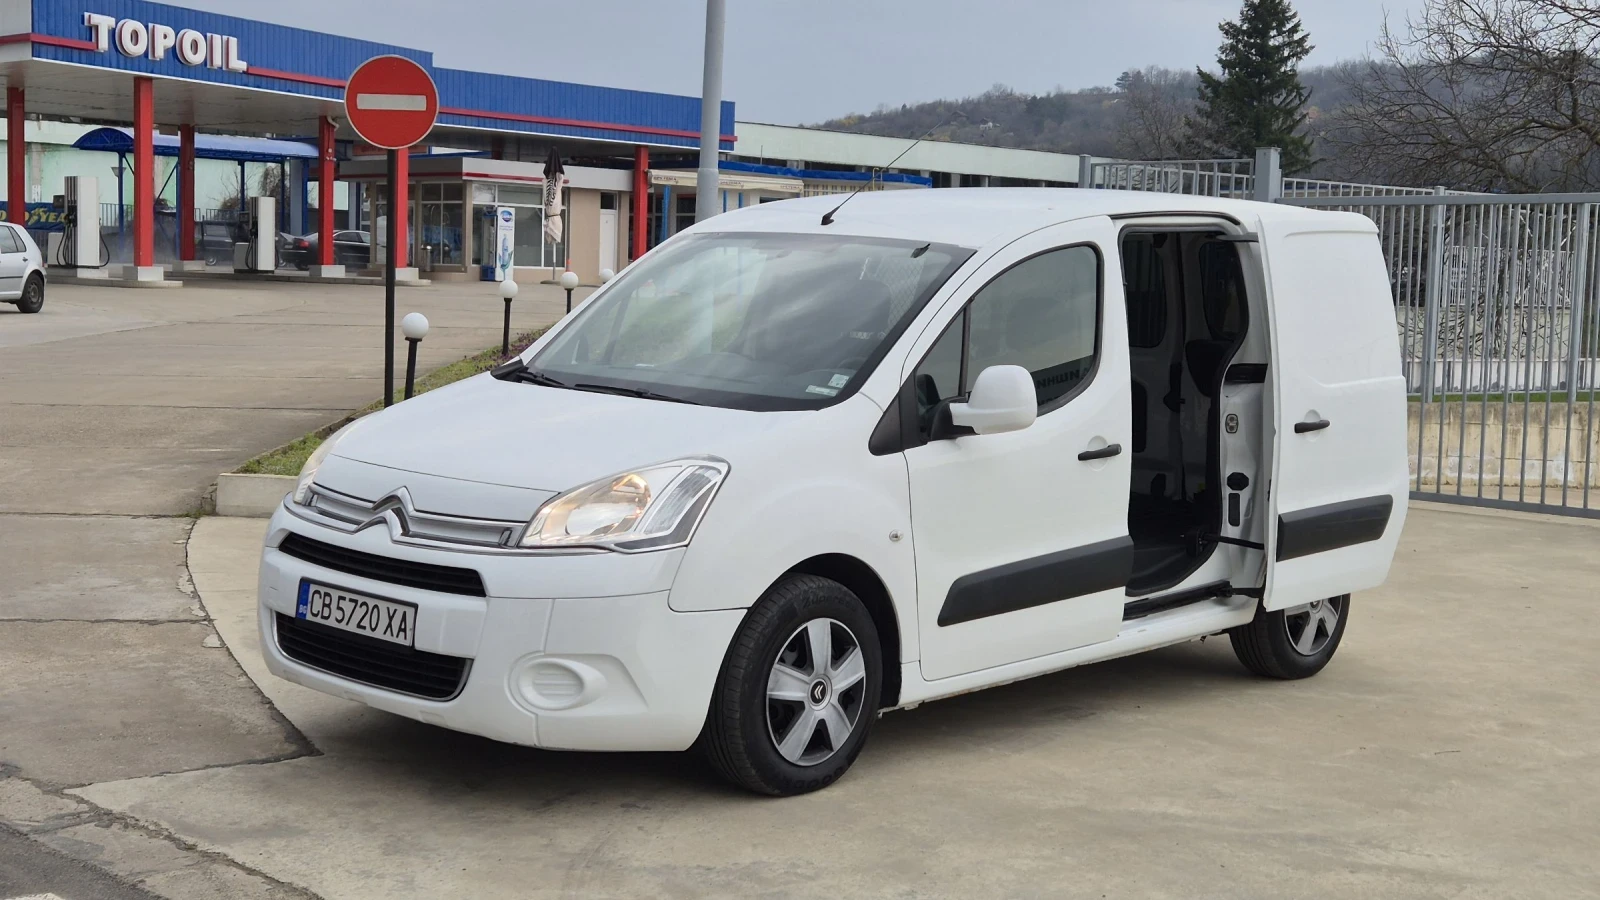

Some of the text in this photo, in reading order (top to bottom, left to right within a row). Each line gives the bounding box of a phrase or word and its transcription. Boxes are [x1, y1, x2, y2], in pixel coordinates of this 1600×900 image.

[84, 12, 247, 73] TOPOIL
[299, 604, 307, 614] BG
[310, 589, 408, 641] CB 5720 XA
